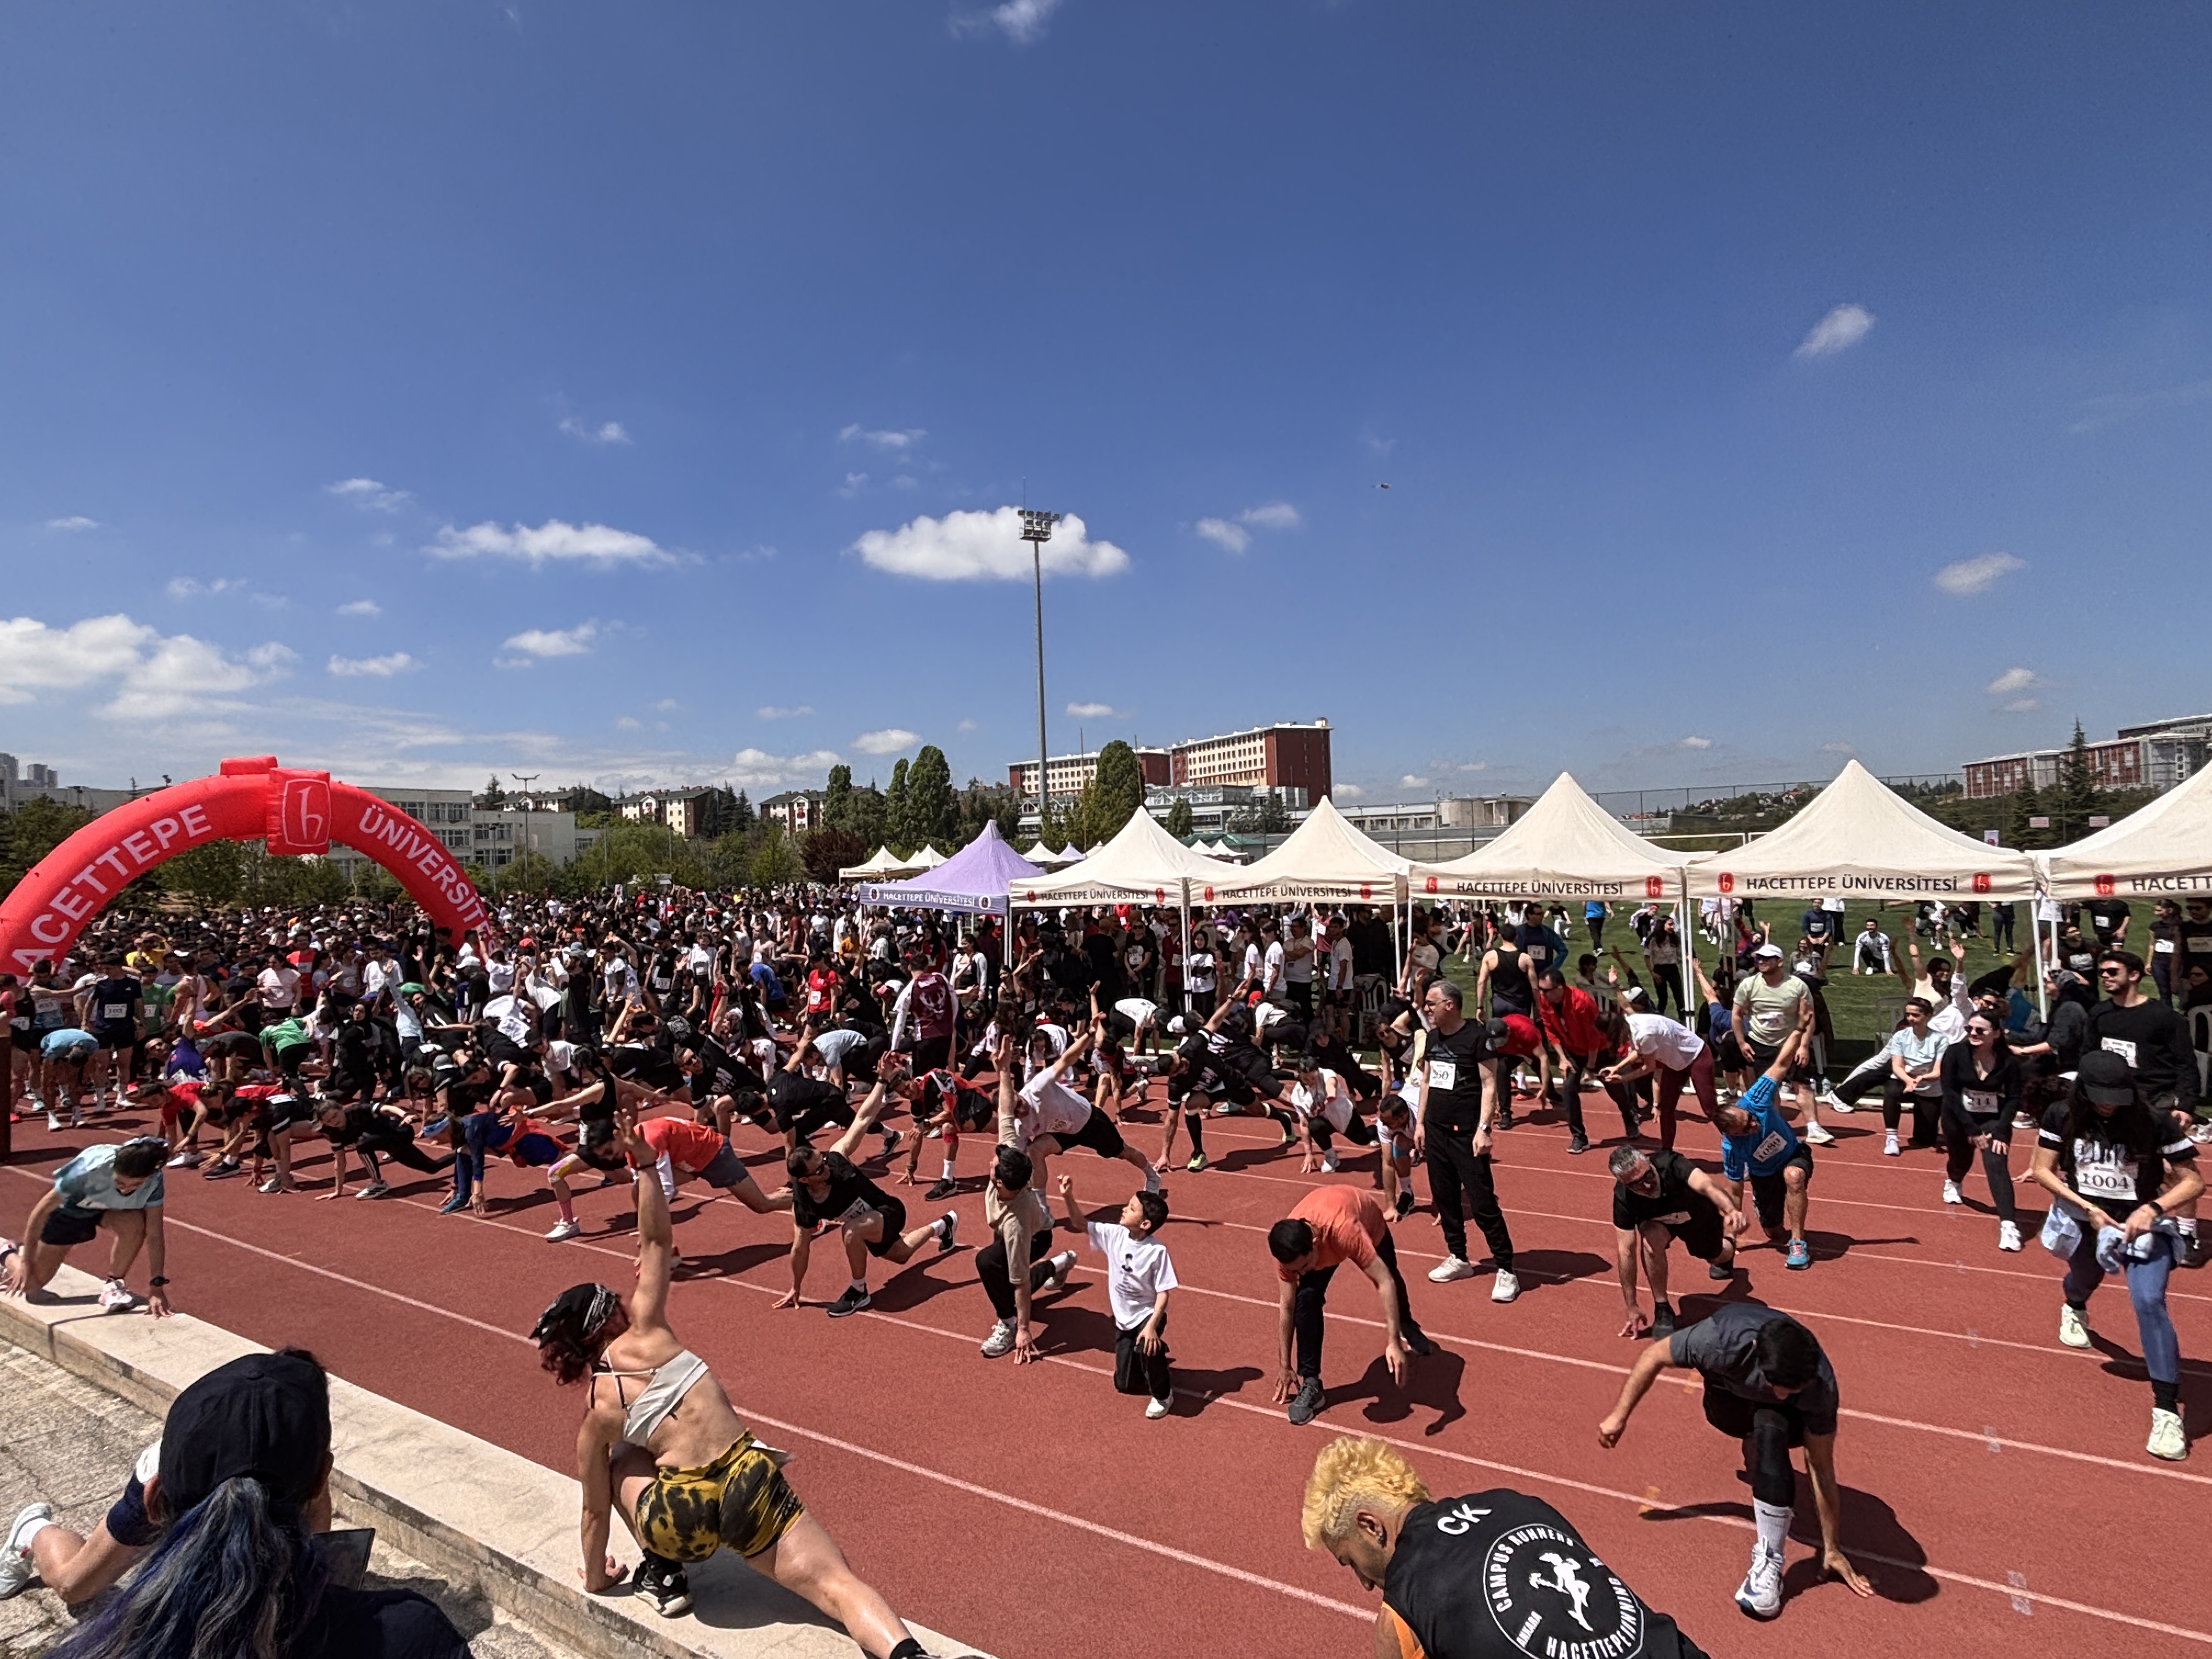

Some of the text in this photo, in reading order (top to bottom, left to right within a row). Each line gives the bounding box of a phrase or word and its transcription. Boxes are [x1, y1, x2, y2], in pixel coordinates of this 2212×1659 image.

[1457, 879, 1623, 895] HACETTEPE ÜNİVERSİTESİ
[1747, 873, 1957, 891] HACETTEPE ÜNİVERSİTESİ
[2131, 876, 2212, 891] HACETT
[883, 891, 923, 902] HACETTEPE
[1040, 890, 1087, 901] HACETTEPE
[1222, 884, 1351, 899] HACETTEPE ÜNİVERSİTESİ
[2083, 1173, 2129, 1189] 1004
[1437, 1503, 1492, 1535] CK
[1488, 1527, 1574, 1613] CAMPUS RUNNERS
[1516, 1611, 1543, 1648] ANKARA
